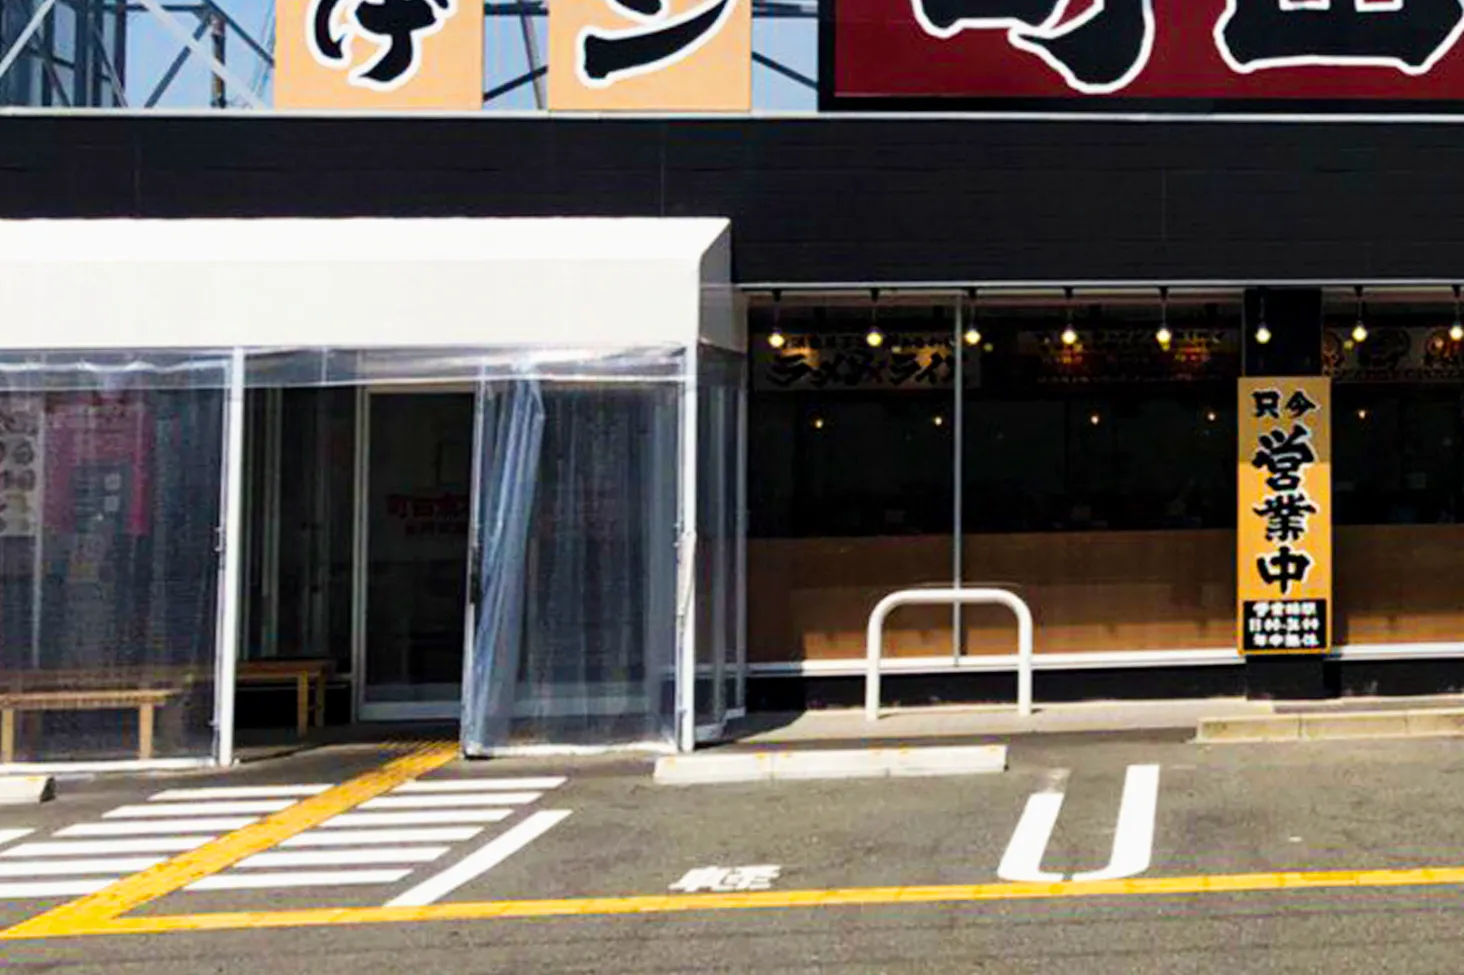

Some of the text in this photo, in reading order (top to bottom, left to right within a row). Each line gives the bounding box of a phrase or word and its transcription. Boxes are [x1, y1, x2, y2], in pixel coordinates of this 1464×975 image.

[1251, 389, 1321, 418] 只今
[1252, 424, 1320, 595] 営業中
